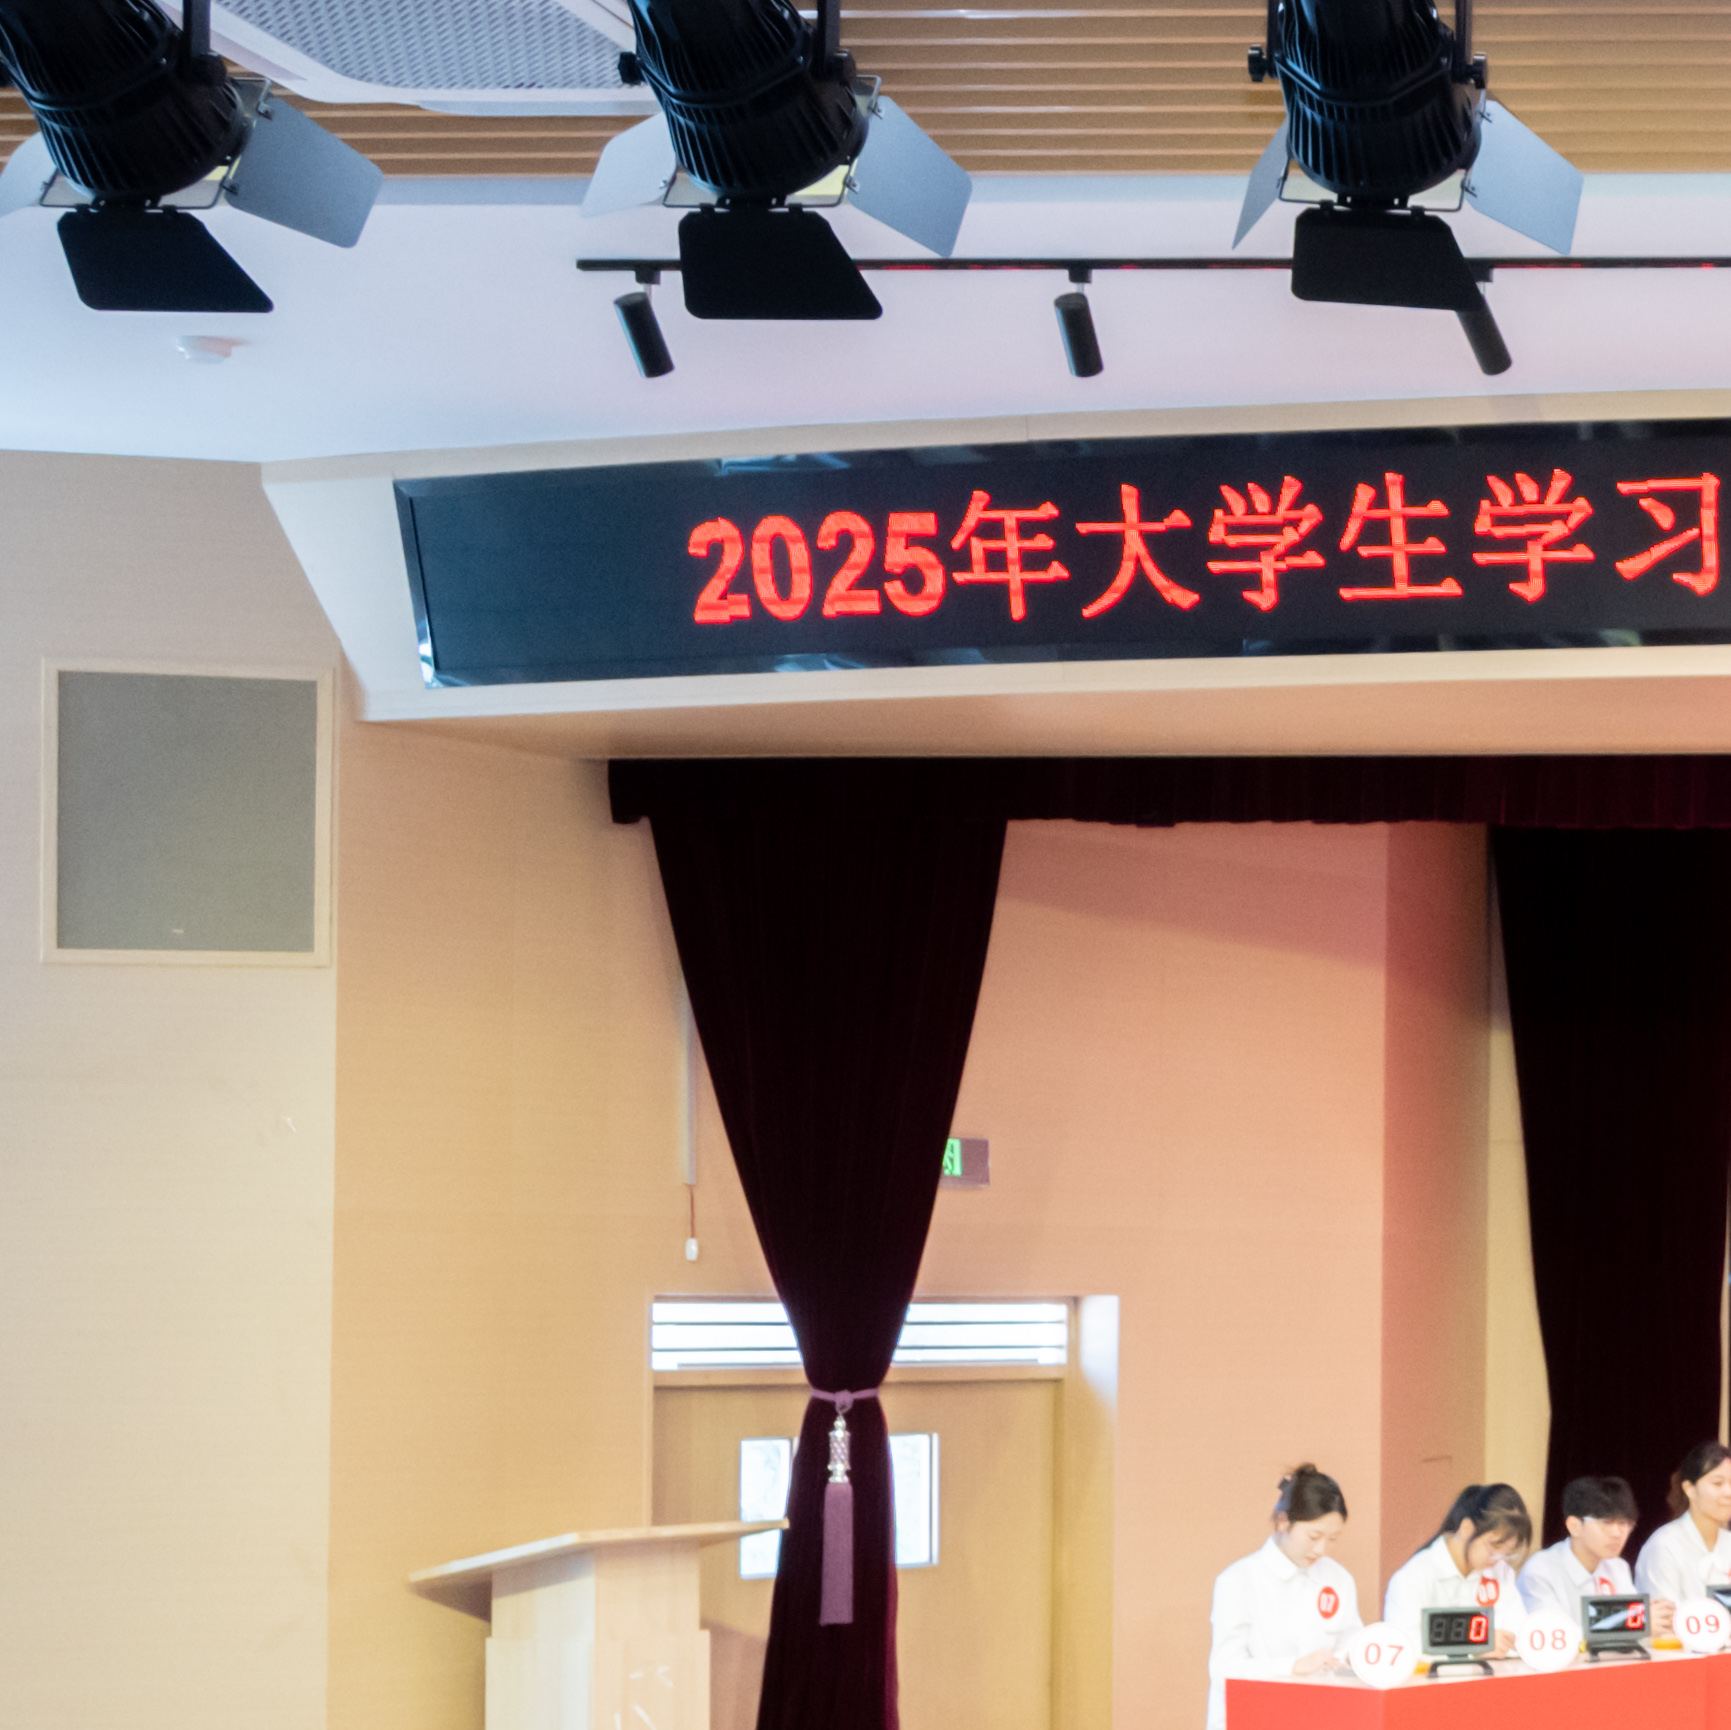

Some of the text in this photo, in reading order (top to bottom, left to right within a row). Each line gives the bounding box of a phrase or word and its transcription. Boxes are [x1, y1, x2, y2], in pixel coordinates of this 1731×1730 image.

[1686, 1615, 1721, 1636] 09
[1530, 1629, 1568, 1652] 08
[1364, 1643, 1405, 1667] 07
